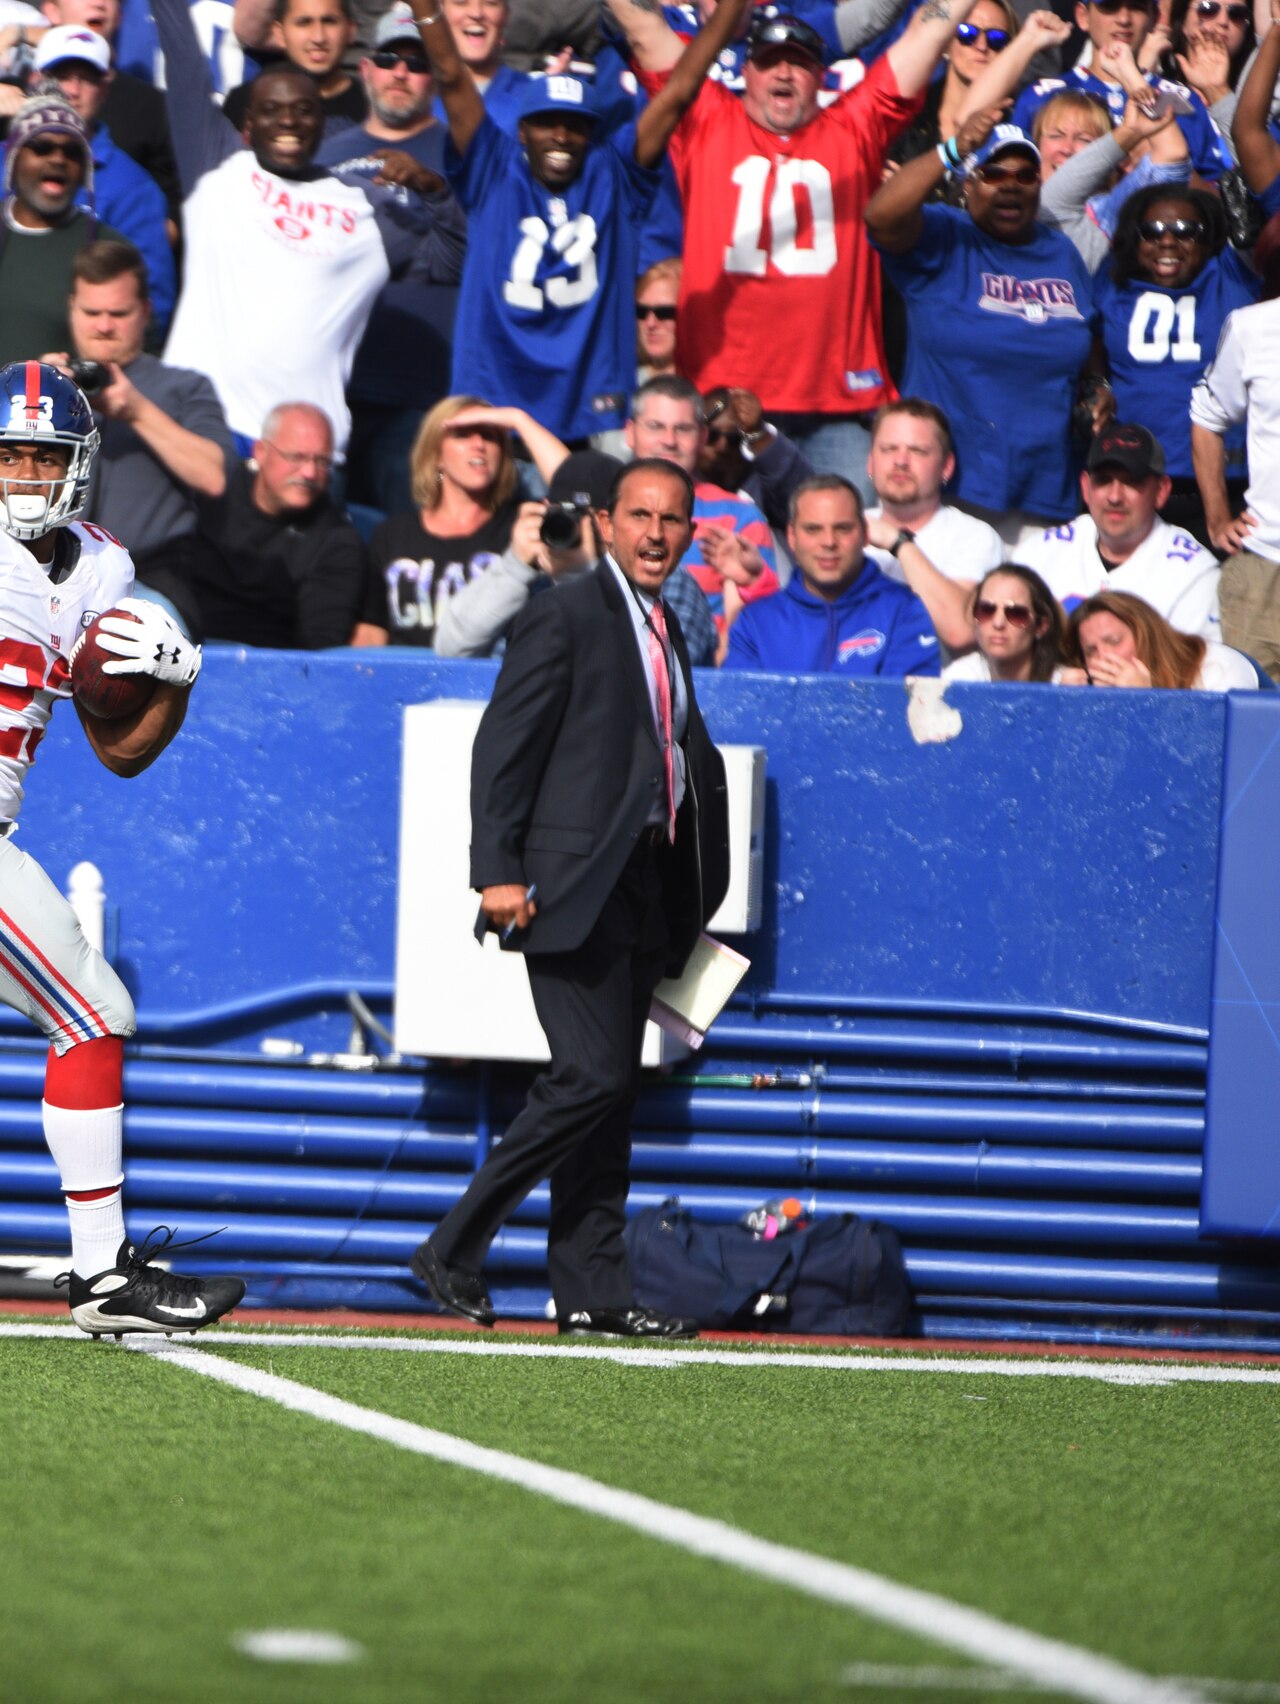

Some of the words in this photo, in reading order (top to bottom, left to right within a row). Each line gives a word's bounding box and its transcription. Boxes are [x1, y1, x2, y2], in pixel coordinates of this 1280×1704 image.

[251, 171, 358, 235] GIANTS
[723, 155, 838, 276] 10
[503, 213, 599, 312] 13
[981, 273, 1075, 306] GIANTS
[1128, 291, 1201, 362] 01
